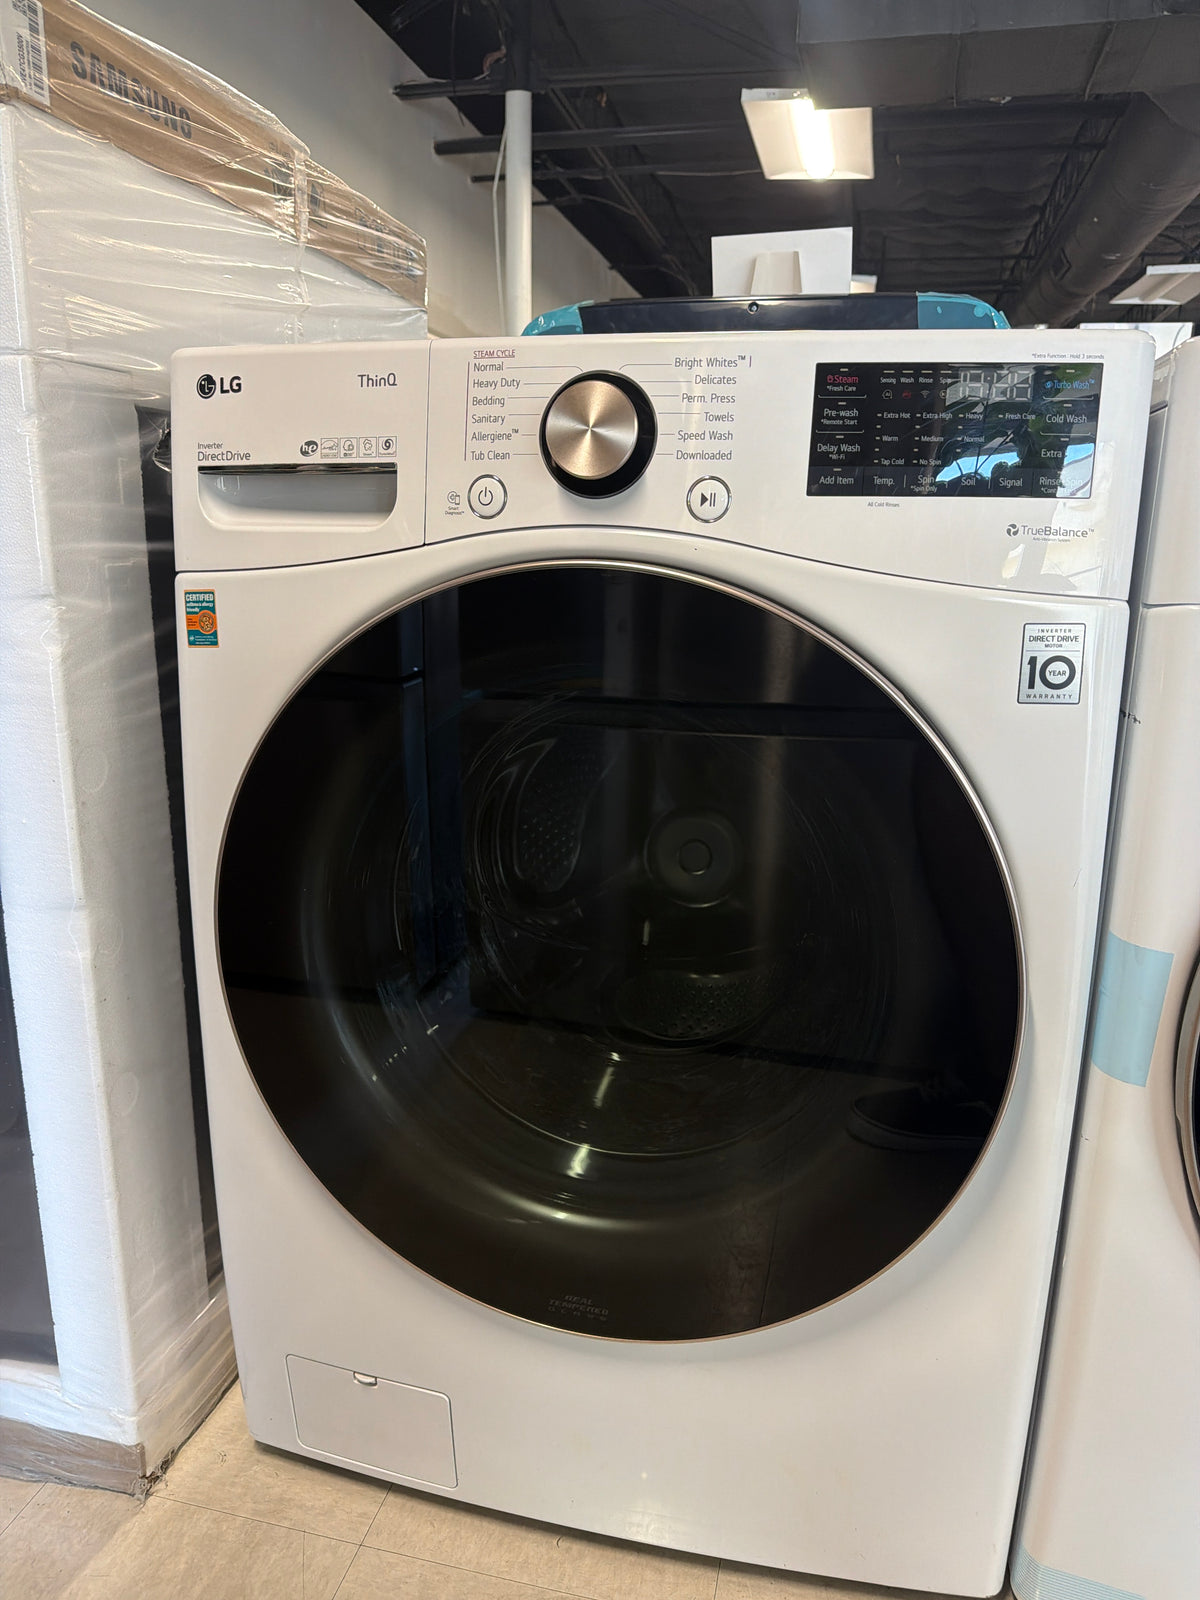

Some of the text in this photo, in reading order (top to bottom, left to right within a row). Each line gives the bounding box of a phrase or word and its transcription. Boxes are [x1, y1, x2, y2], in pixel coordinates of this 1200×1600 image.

[70, 41, 192, 139] SAMSUNG
[473, 349, 516, 358] STEAM CYCLE
[473, 362, 504, 372] Normal
[674, 357, 703, 370] Bright
[357, 372, 398, 388] ThinQ
[472, 378, 521, 390] Heavy Duty
[695, 374, 737, 385] Delicates
[834, 375, 859, 383] Steam
[219, 376, 242, 394] LG
[472, 396, 505, 407] Bedding
[682, 393, 736, 404] Perm. Press
[704, 411, 734, 422] Towels
[823, 408, 859, 417] Pre-wash
[939, 412, 952, 420] High
[965, 413, 983, 421] Heavy
[471, 414, 505, 425] Sanitary
[1046, 414, 1087, 423] Cold Wash
[678, 430, 733, 442] Speed Wash
[964, 434, 985, 442] Normal
[197, 442, 223, 450] Inverter
[817, 443, 860, 454] Delay Wash
[471, 450, 511, 461] Tub Clean
[676, 449, 732, 460] Downloaded
[1041, 449, 1062, 457] Extra
[819, 476, 854, 485] Add Item
[873, 476, 895, 486] Temp.
[918, 475, 935, 486] Spin
[961, 477, 976, 486] Soil
[1000, 478, 1023, 488] Signal
[925, 485, 938, 493] Only
[186, 593, 214, 601] CERTIFIED
[1029, 635, 1080, 643] DIRECT DRIVE
[1027, 655, 1076, 690] 10
